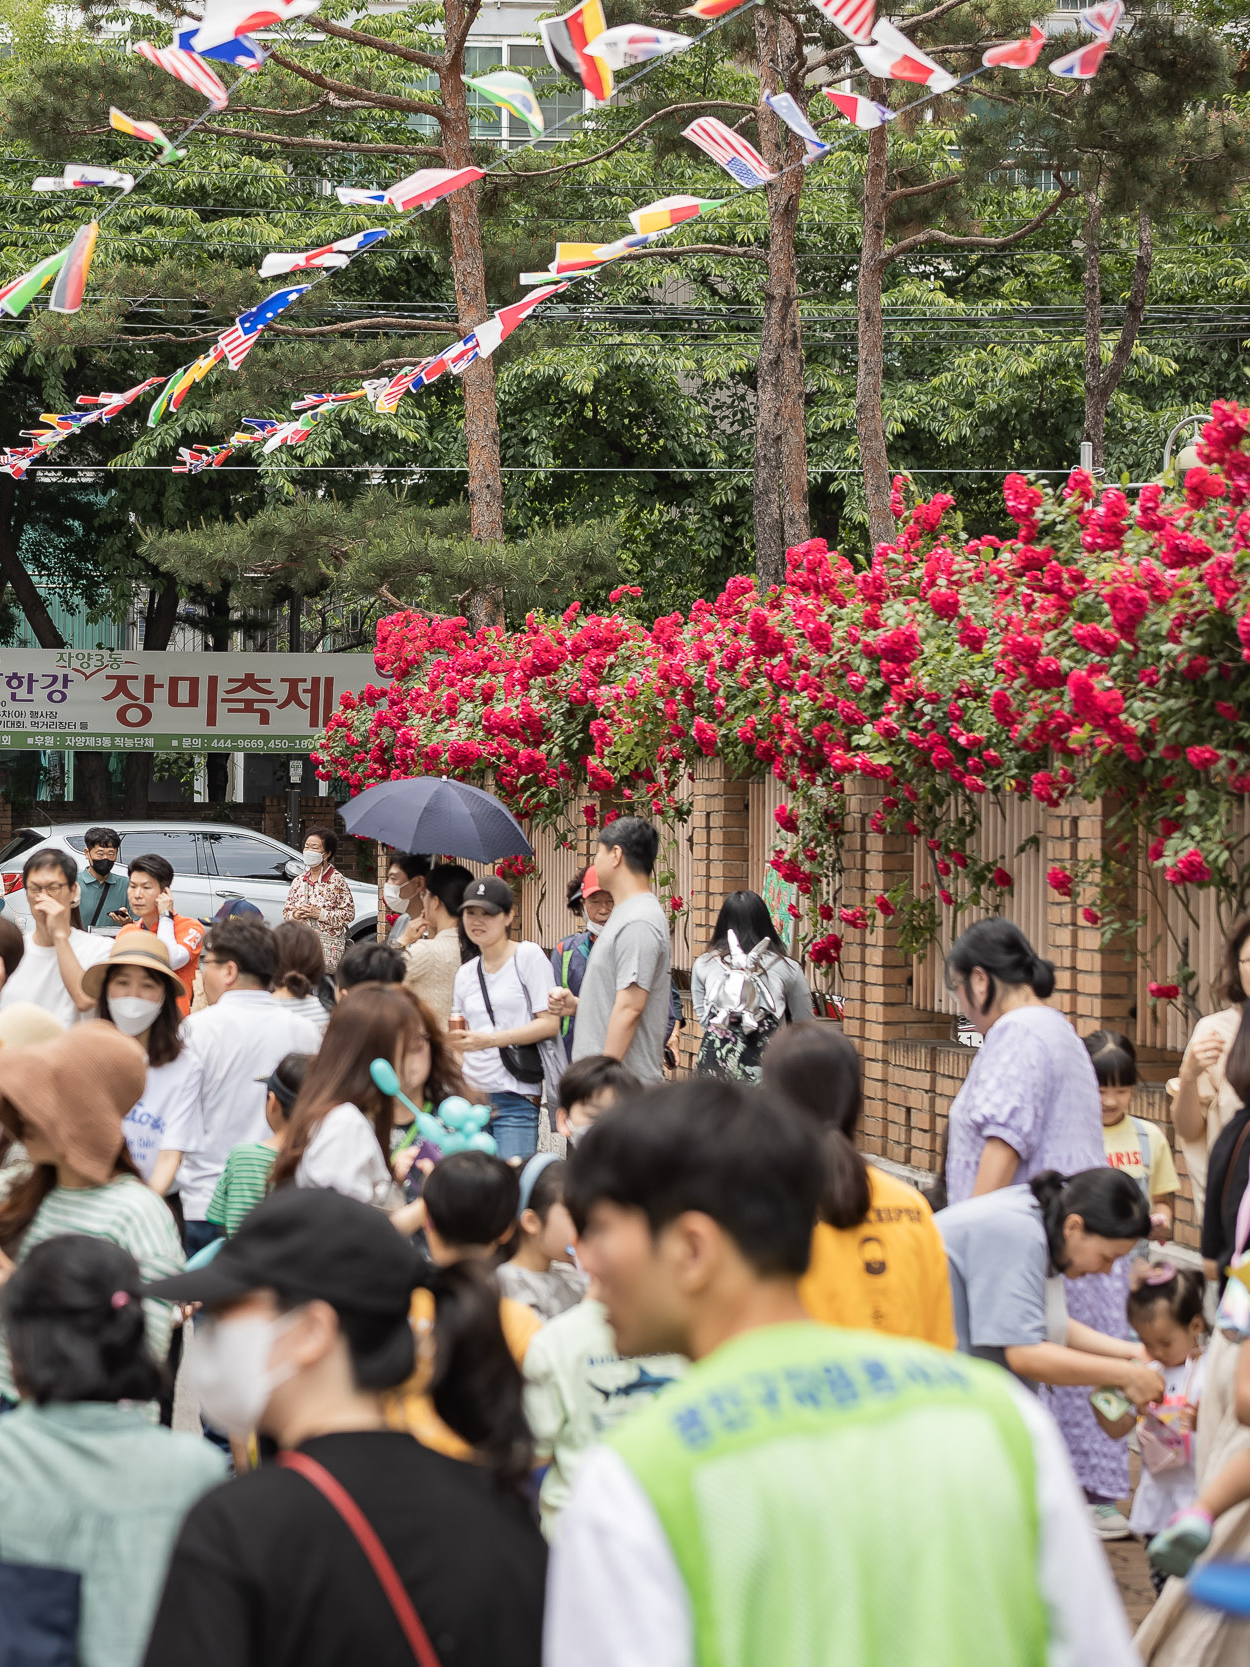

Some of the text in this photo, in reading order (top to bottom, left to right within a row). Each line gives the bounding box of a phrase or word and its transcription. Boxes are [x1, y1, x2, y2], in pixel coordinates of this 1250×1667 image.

[55, 651, 124, 670] 자양3동
[101, 672, 335, 729] 장미축제
[30, 710, 58, 719] 행사장
[31, 720, 77, 730] 먹거리장터
[79, 721, 89, 730] 등
[34, 735, 54, 747] 후원
[65, 736, 111, 747] 자양제3동
[114, 737, 154, 748] 직능단체
[181, 737, 201, 748] 문의
[183, 928, 201, 950] 23
